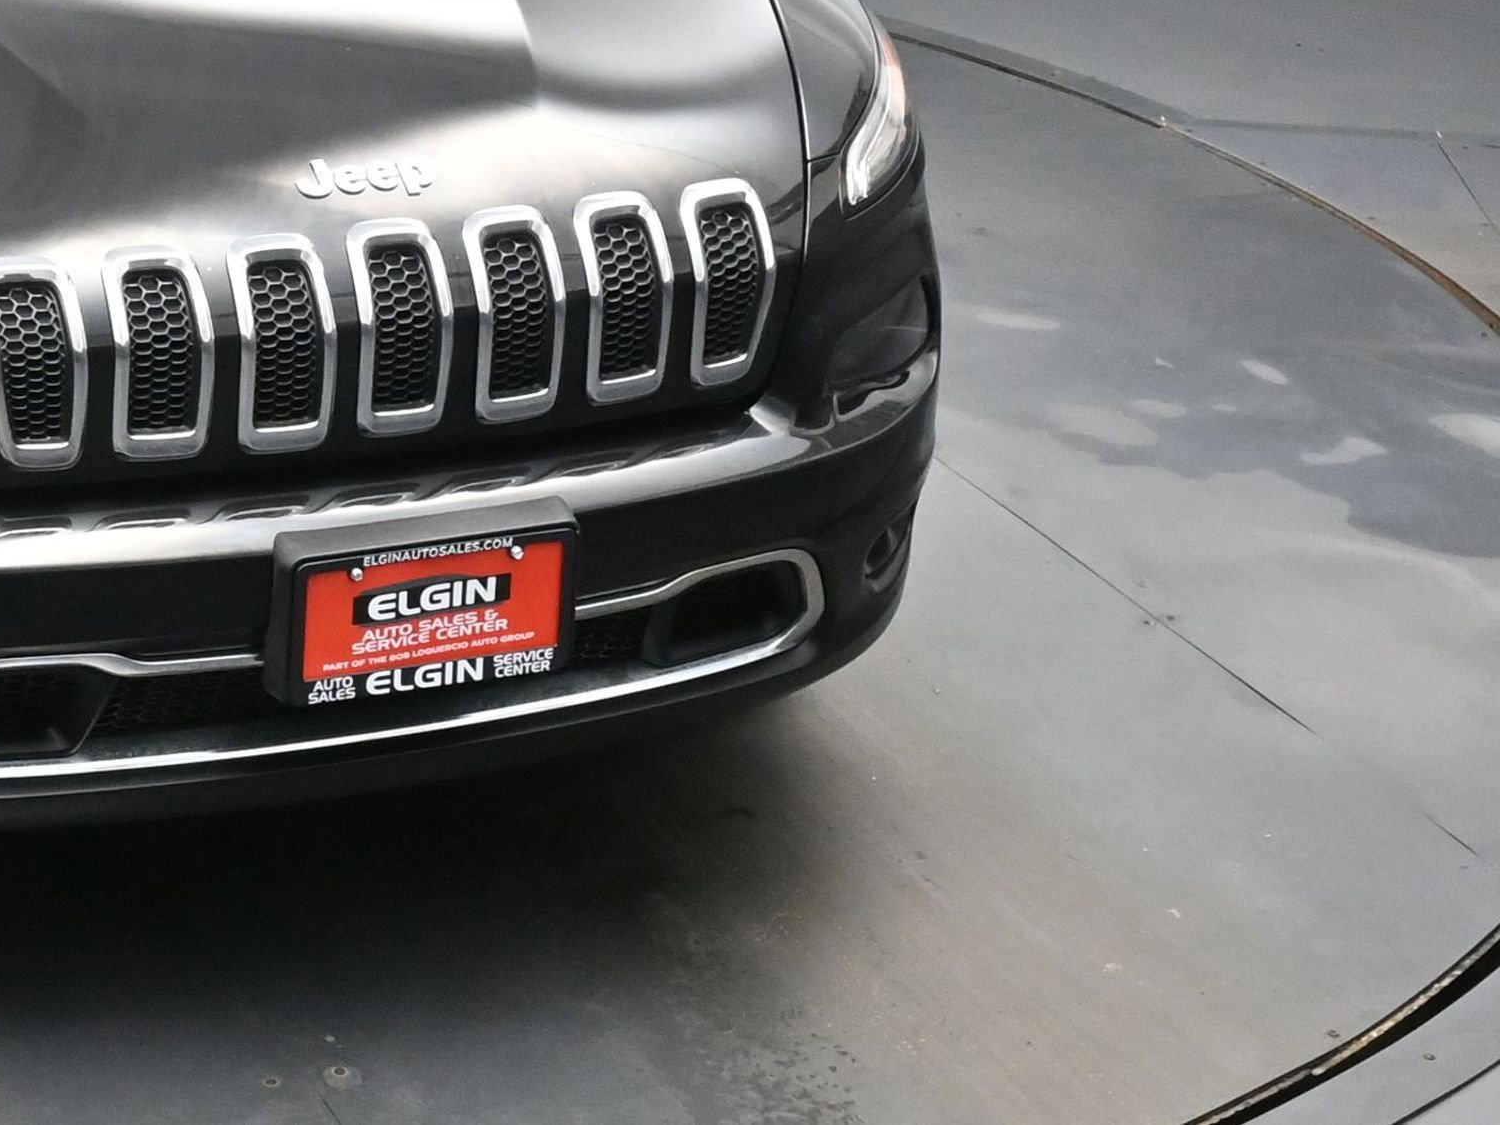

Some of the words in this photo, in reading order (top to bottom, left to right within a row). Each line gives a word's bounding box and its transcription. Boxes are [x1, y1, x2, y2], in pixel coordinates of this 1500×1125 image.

[294, 157, 435, 199] Jeep
[363, 537, 514, 567] ELGINAUTOSALES.COM
[367, 576, 497, 621] ELGIN
[351, 631, 431, 655] SERVICE
[435, 618, 509, 641] CENTER
[361, 623, 412, 641] AUTO
[417, 611, 478, 633] SALES
[484, 608, 499, 622] &
[322, 661, 350, 672] PART
[351, 658, 366, 668] OF
[367, 655, 388, 665] THE
[412, 641, 469, 659] LOQUERCIO
[470, 635, 498, 648] AUTO
[500, 631, 536, 644] GROUP
[493, 647, 554, 668] SERVICE
[312, 676, 354, 692] AUTO
[366, 656, 484, 696] ELGIN
[494, 659, 551, 679] CENTER
[307, 687, 356, 705] SALES
